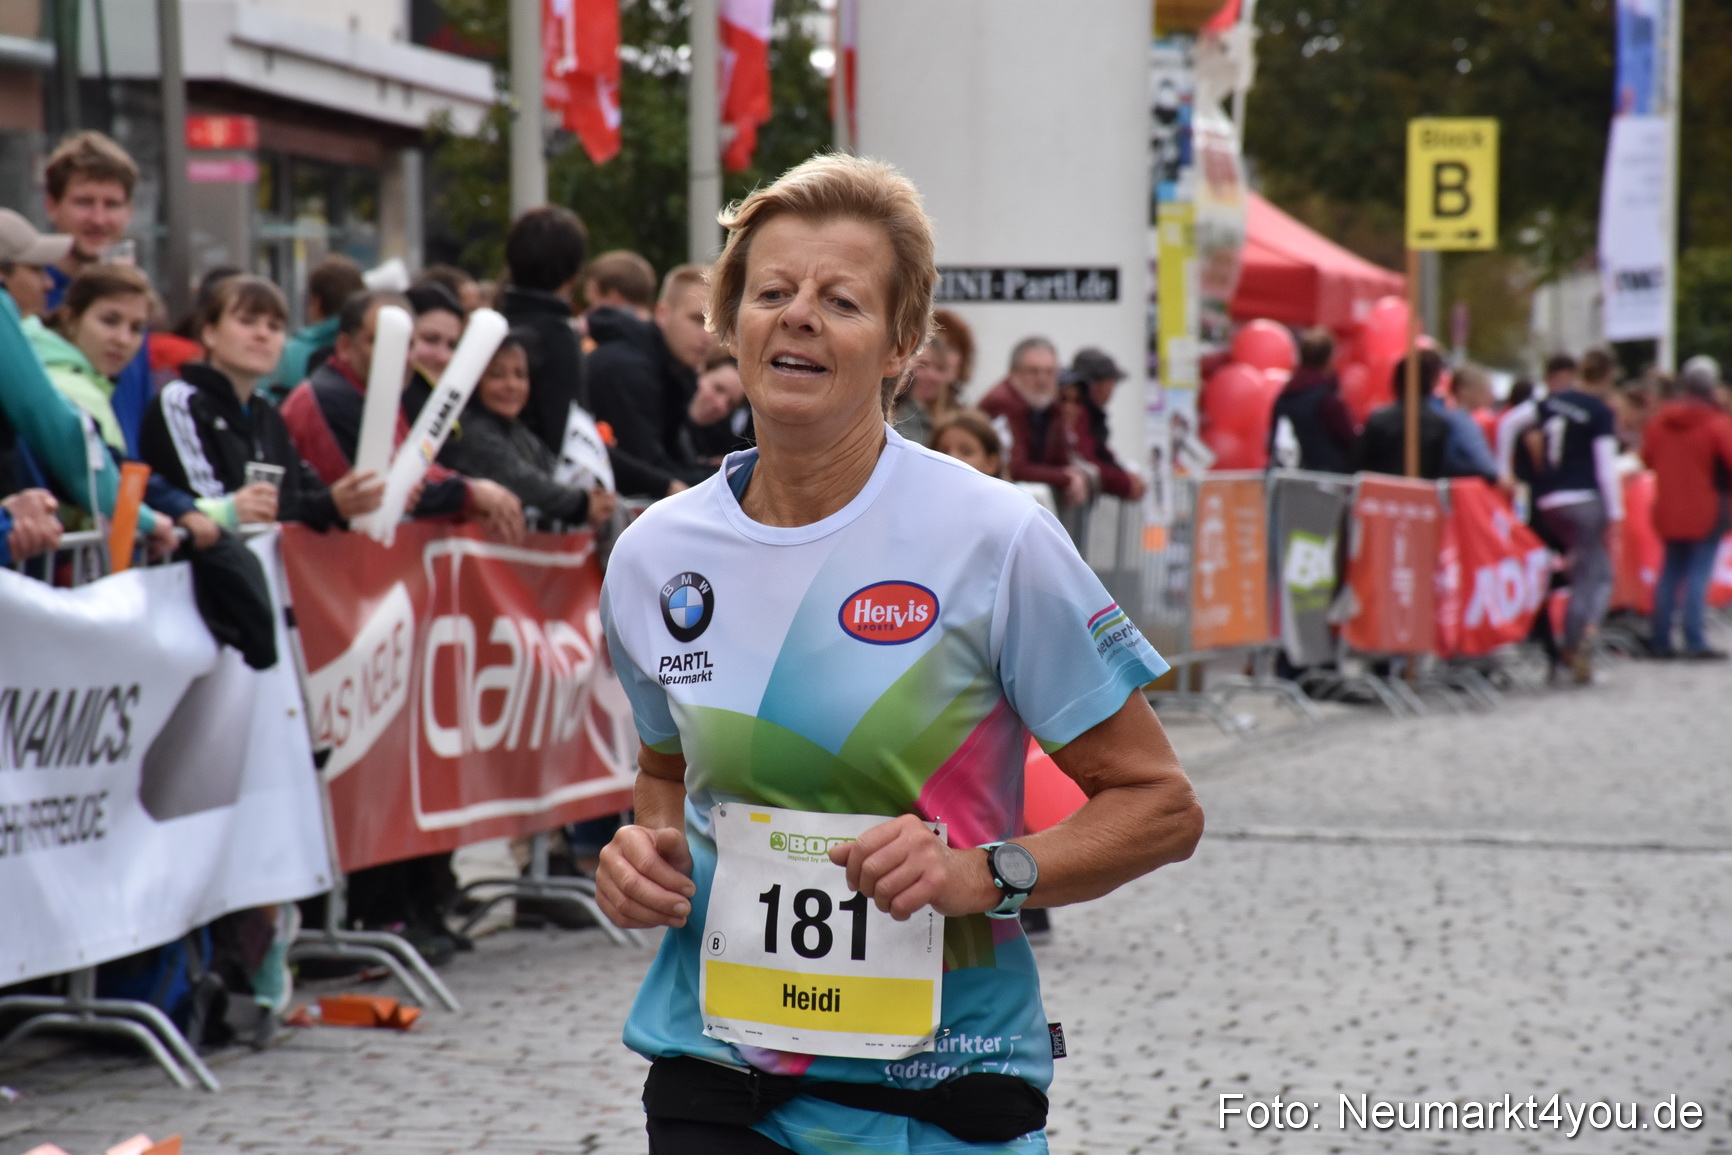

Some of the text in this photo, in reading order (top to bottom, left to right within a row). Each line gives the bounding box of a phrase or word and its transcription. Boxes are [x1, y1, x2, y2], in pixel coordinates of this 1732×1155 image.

[1432, 160, 1472, 218] B
[662, 574, 710, 597] BMW
[853, 599, 928, 627] Hervis
[1097, 621, 1137, 659] NeuerM
[659, 651, 713, 672] PARTL
[659, 670, 712, 686] Neumarkt
[788, 854, 810, 862] inspired
[759, 884, 868, 961] 181
[712, 937, 720, 950] B
[783, 983, 840, 1013] Heidi
[937, 1033, 1002, 1054] arkter
